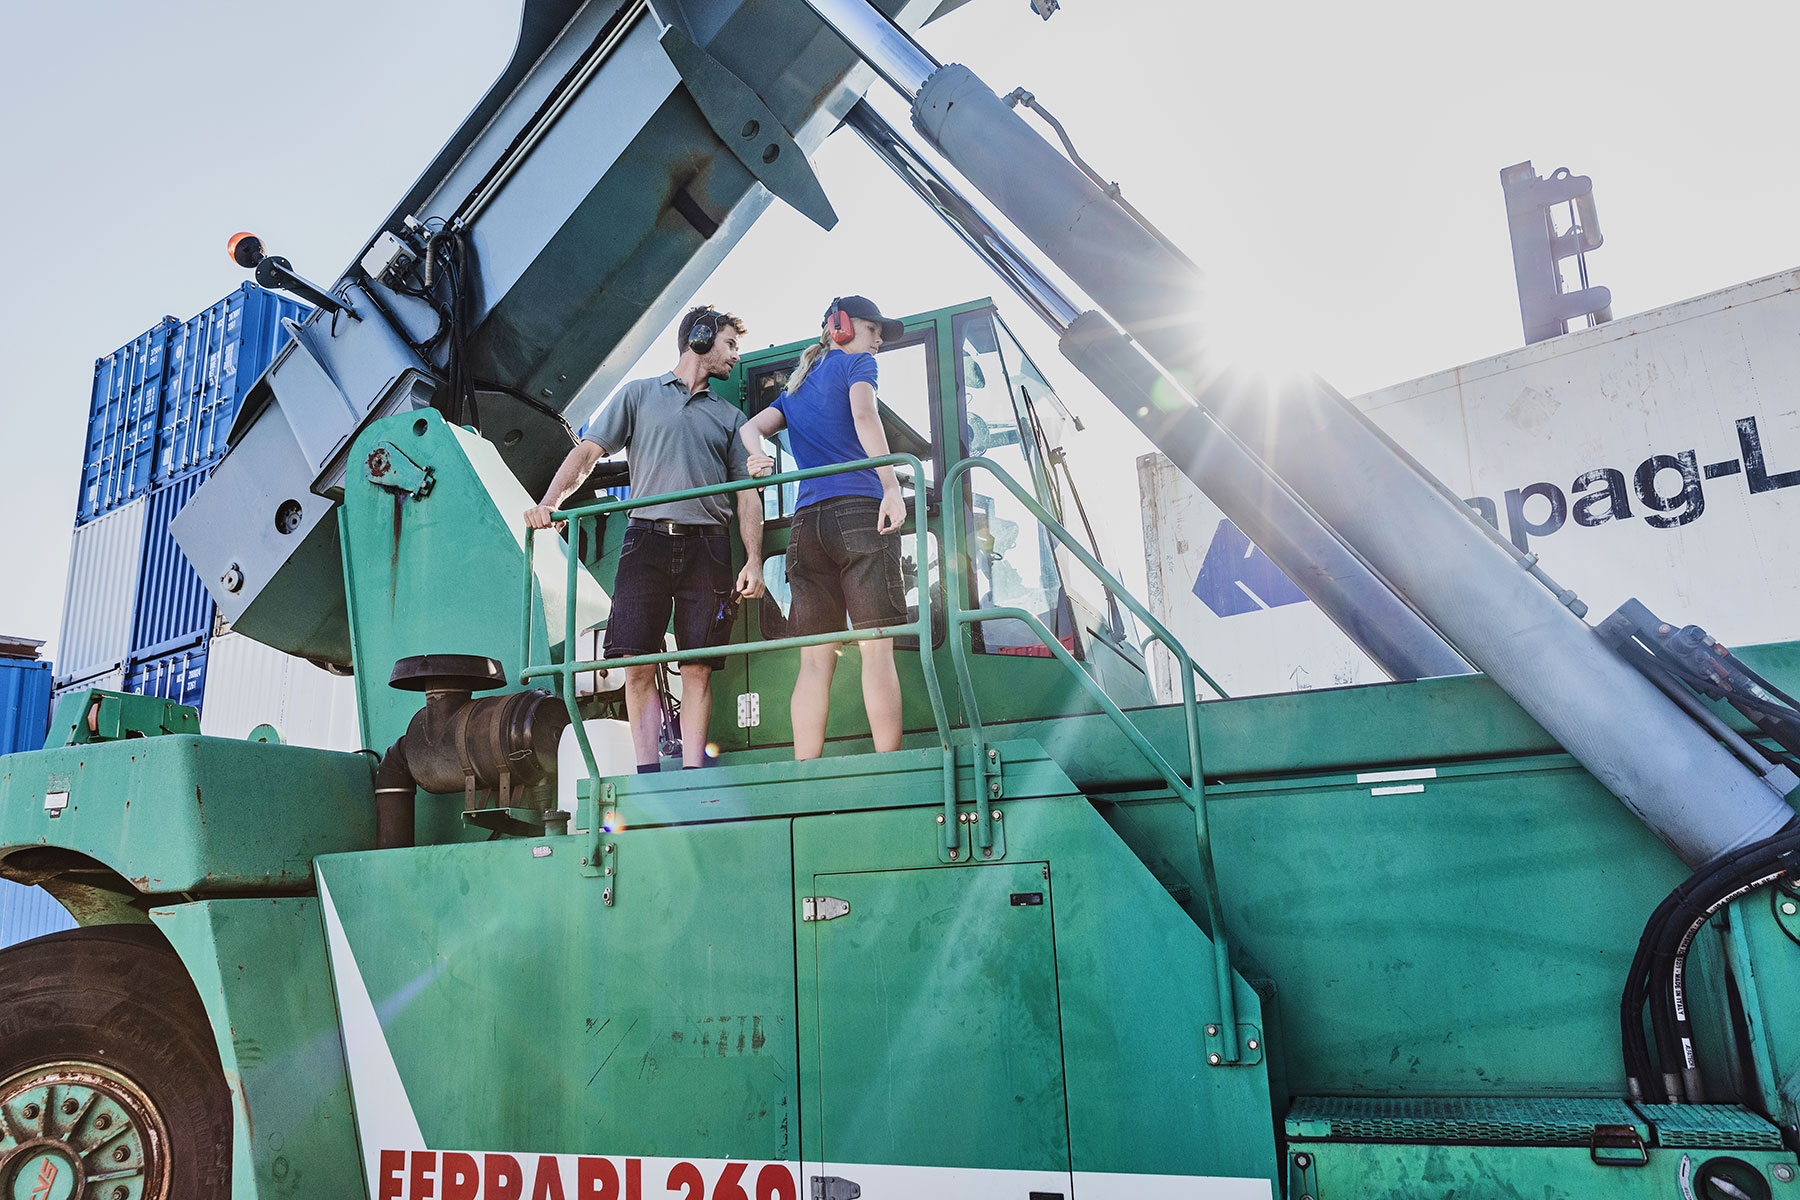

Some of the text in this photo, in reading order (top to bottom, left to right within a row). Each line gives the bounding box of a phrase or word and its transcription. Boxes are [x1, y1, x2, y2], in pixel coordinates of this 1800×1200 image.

[1674, 973, 1682, 989] MADE
[1675, 990, 1682, 999] IN
[1676, 999, 1685, 1016] ITALY
[378, 1150, 642, 1200] FERRARI
